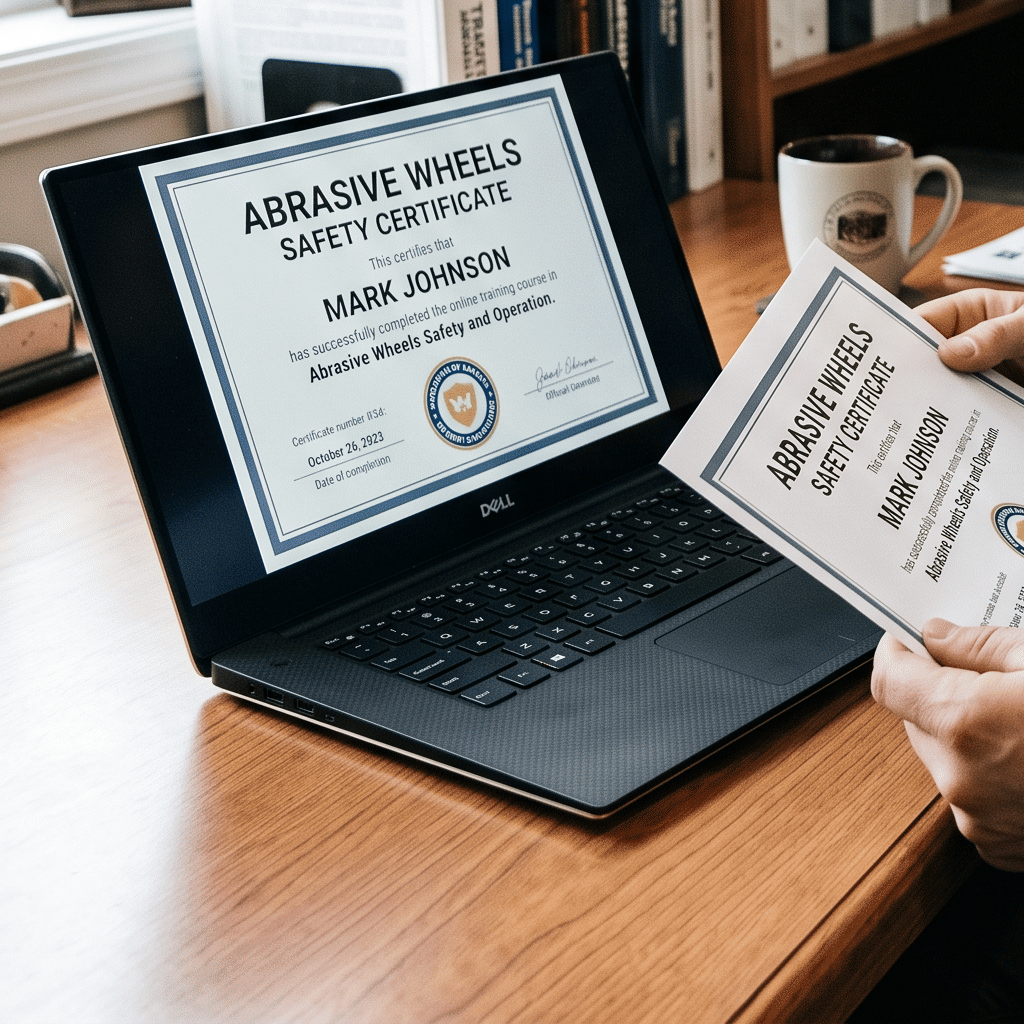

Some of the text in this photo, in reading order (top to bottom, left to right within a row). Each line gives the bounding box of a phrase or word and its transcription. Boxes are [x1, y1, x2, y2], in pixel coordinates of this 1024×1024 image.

[245, 137, 522, 235] ABRASIVE WHEELS
[280, 180, 512, 261] SAFETY CERTIFICATE
[322, 245, 511, 322] MARK JOHNSON
[368, 237, 455, 270] This certifies that
[289, 269, 558, 363] has successfully completed the online training course in
[310, 293, 556, 384] Abrasive Wheels Safety and Operation.
[766, 386, 837, 491] ABRASIVE
[817, 322, 873, 396] WHEELS
[811, 355, 896, 497] SAFETY CERTIFICATE
[314, 476, 335, 490] Date
[480, 493, 515, 518] DELL
[877, 406, 949, 530] MARK JOHNSON
[969, 462, 984, 483] and
